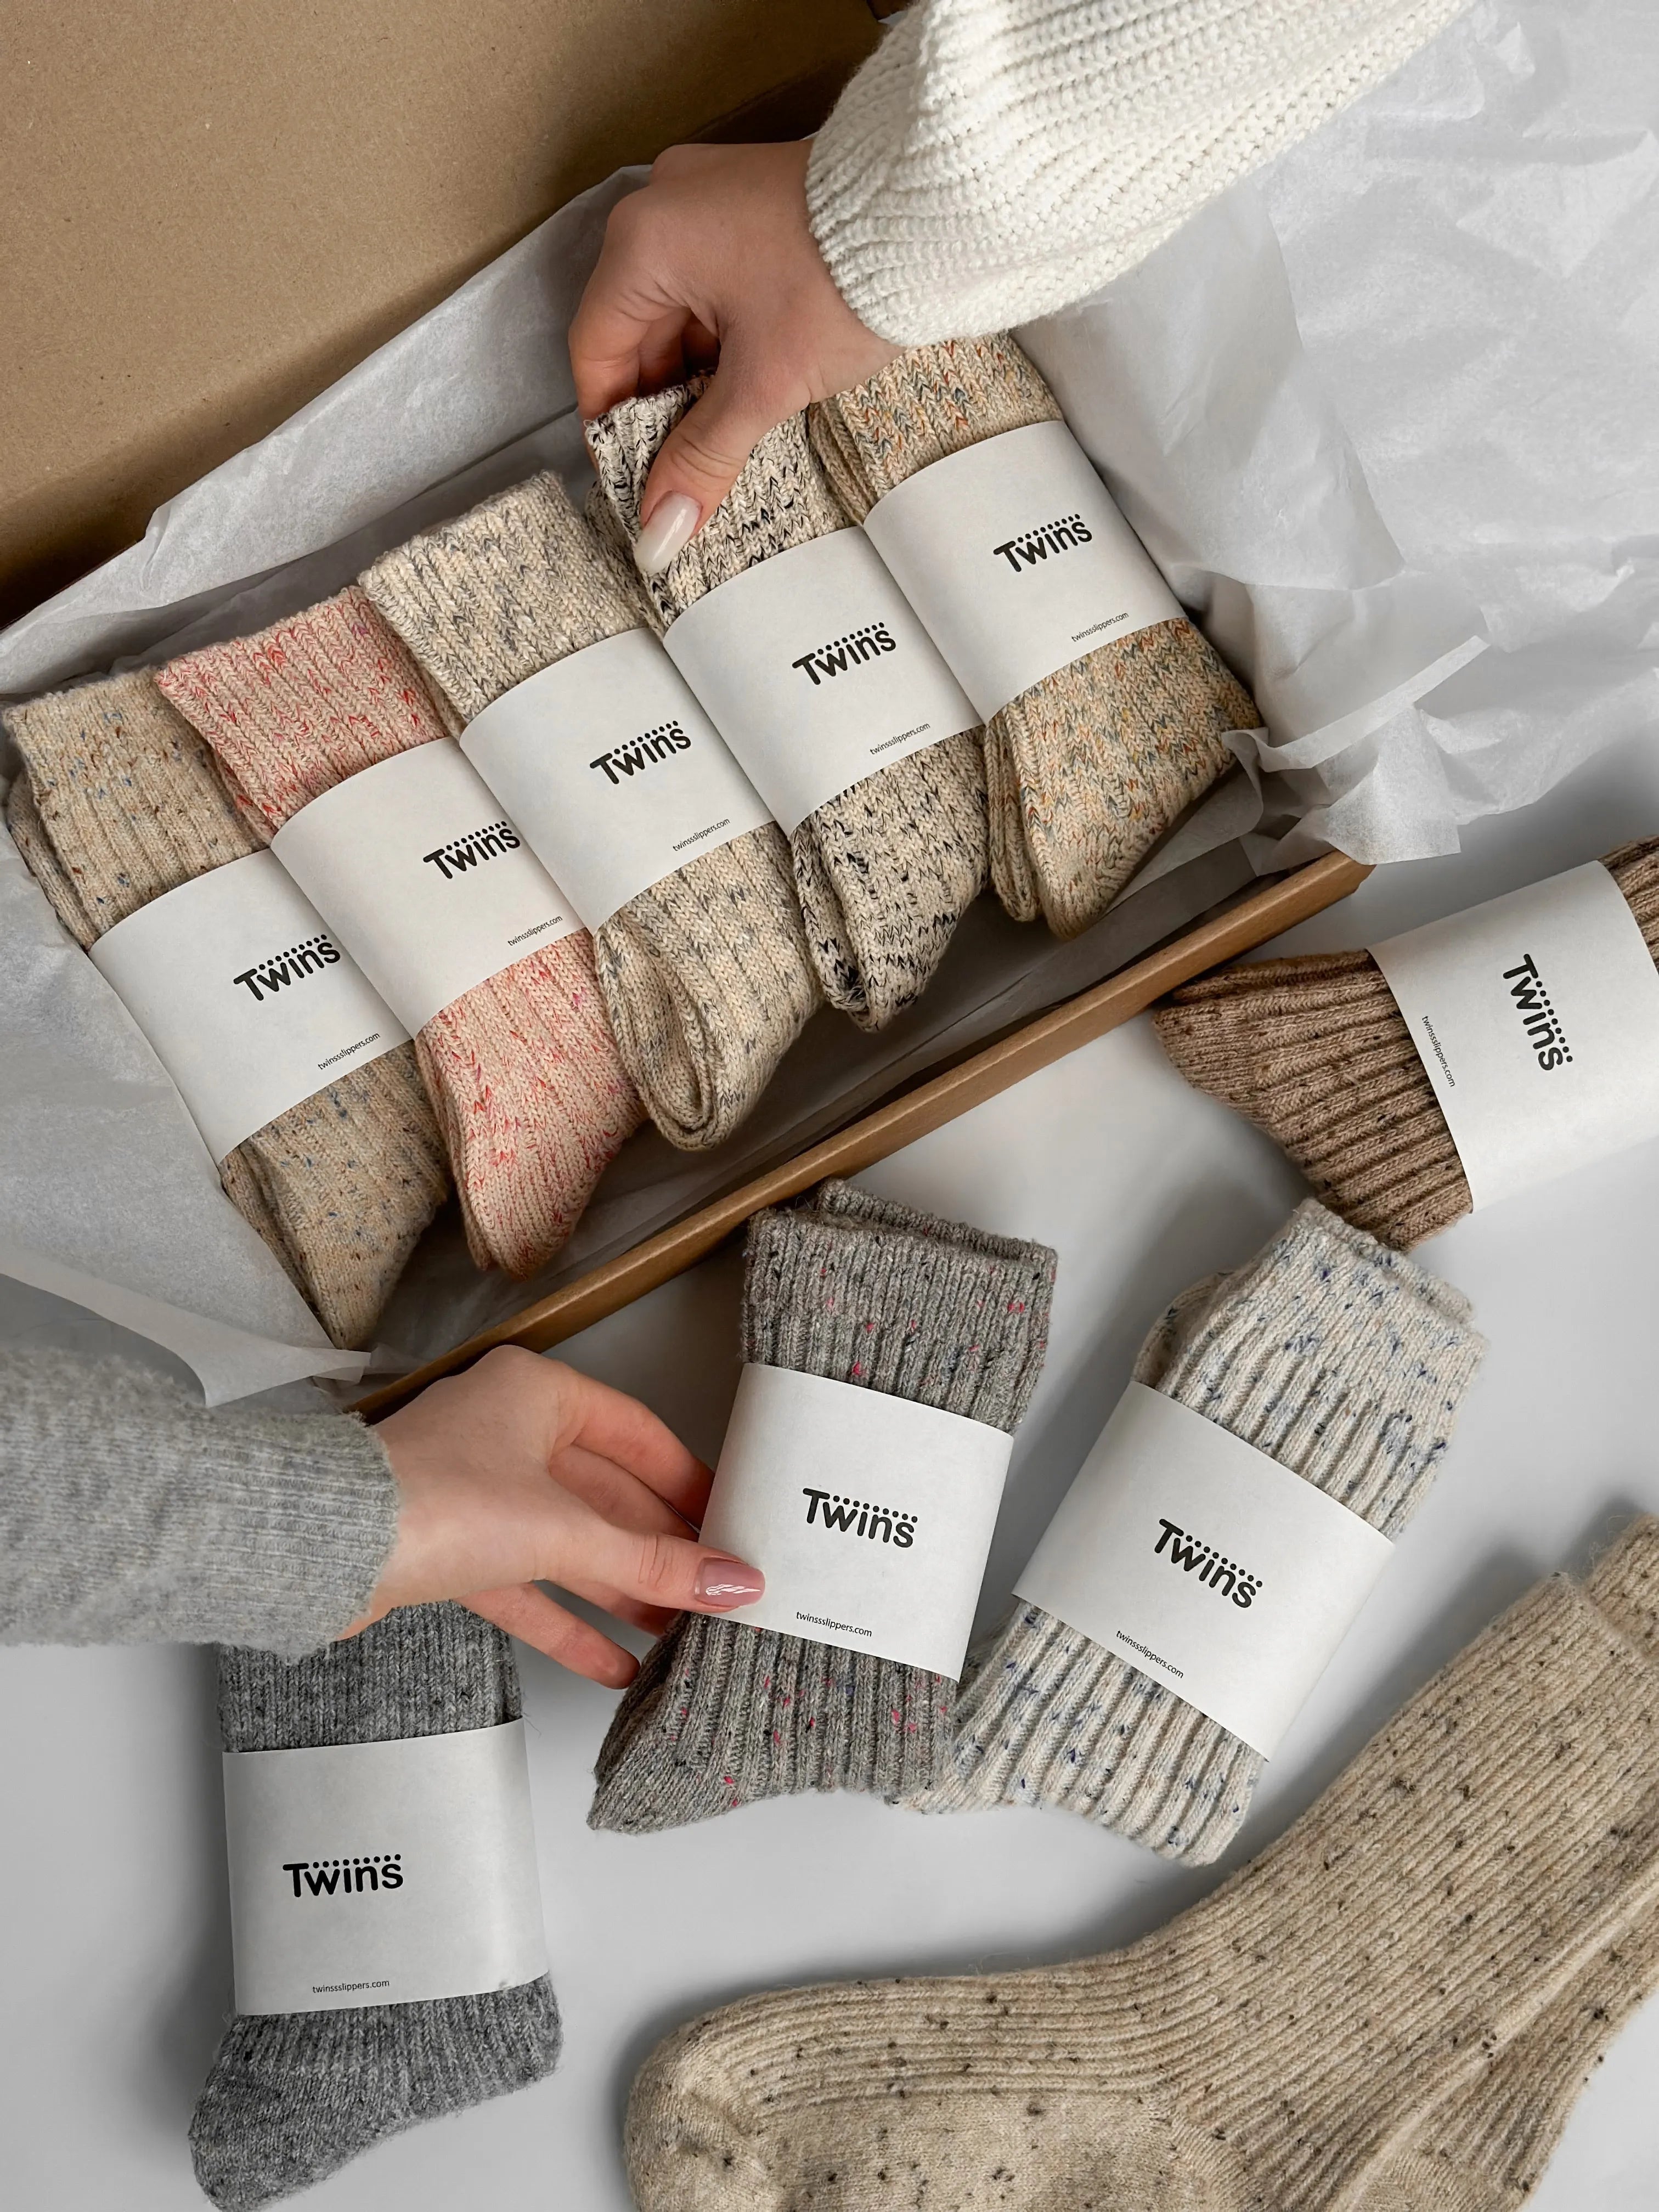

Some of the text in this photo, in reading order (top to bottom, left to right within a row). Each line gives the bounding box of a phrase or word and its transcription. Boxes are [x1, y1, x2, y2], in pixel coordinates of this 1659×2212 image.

[993, 514, 1092, 572] Twins
[792, 622, 896, 685] Twins
[1071, 611, 1129, 643] twinssslippers.com
[590, 720, 691, 785] Twins
[870, 723, 930, 755] twinssslippers.com
[423, 821, 521, 879] Twins
[673, 818, 730, 852] twinssslippers.com
[507, 915, 563, 946] twinssslippers.com
[233, 934, 341, 1001] Twins
[1503, 954, 1573, 1070] Twins
[318, 1032, 380, 1070] twinssslippers.com
[1421, 1015, 1455, 1087] twinssslippers.com
[803, 1488, 918, 1548] Twins
[1154, 1519, 1262, 1608] Twins
[796, 1611, 872, 1638] twinssslippers.com
[1115, 1630, 1184, 1678] twinssslippers.com
[283, 1854, 403, 1897] Twins
[312, 1979, 390, 1994] twinssslippers.com
